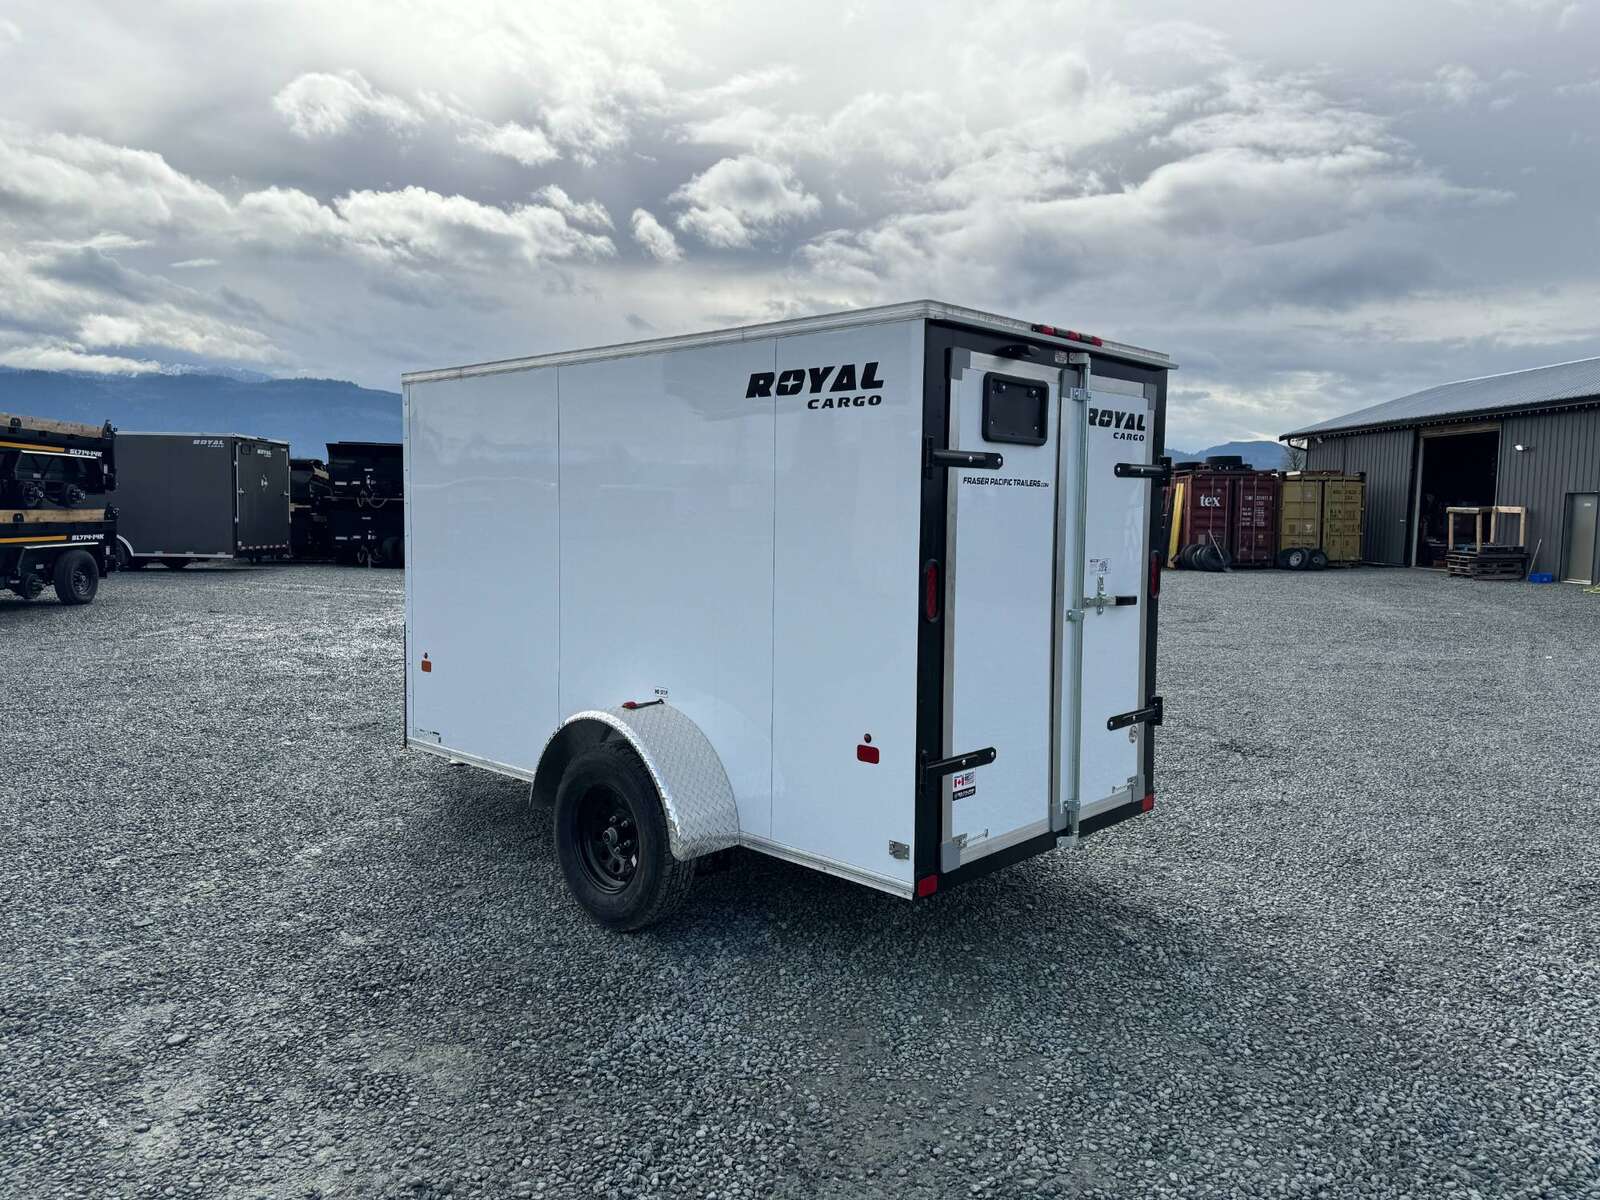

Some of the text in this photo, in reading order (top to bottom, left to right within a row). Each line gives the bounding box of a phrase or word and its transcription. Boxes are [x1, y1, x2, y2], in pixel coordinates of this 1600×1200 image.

[745, 361, 884, 399] ROYAL
[807, 394, 882, 410] CARGO
[1088, 407, 1146, 431] ROYAL
[1113, 432, 1145, 442] CARGO
[962, 476, 989, 486] FRASER
[989, 477, 1013, 487] PACIFIC
[1200, 494, 1221, 507] tex
